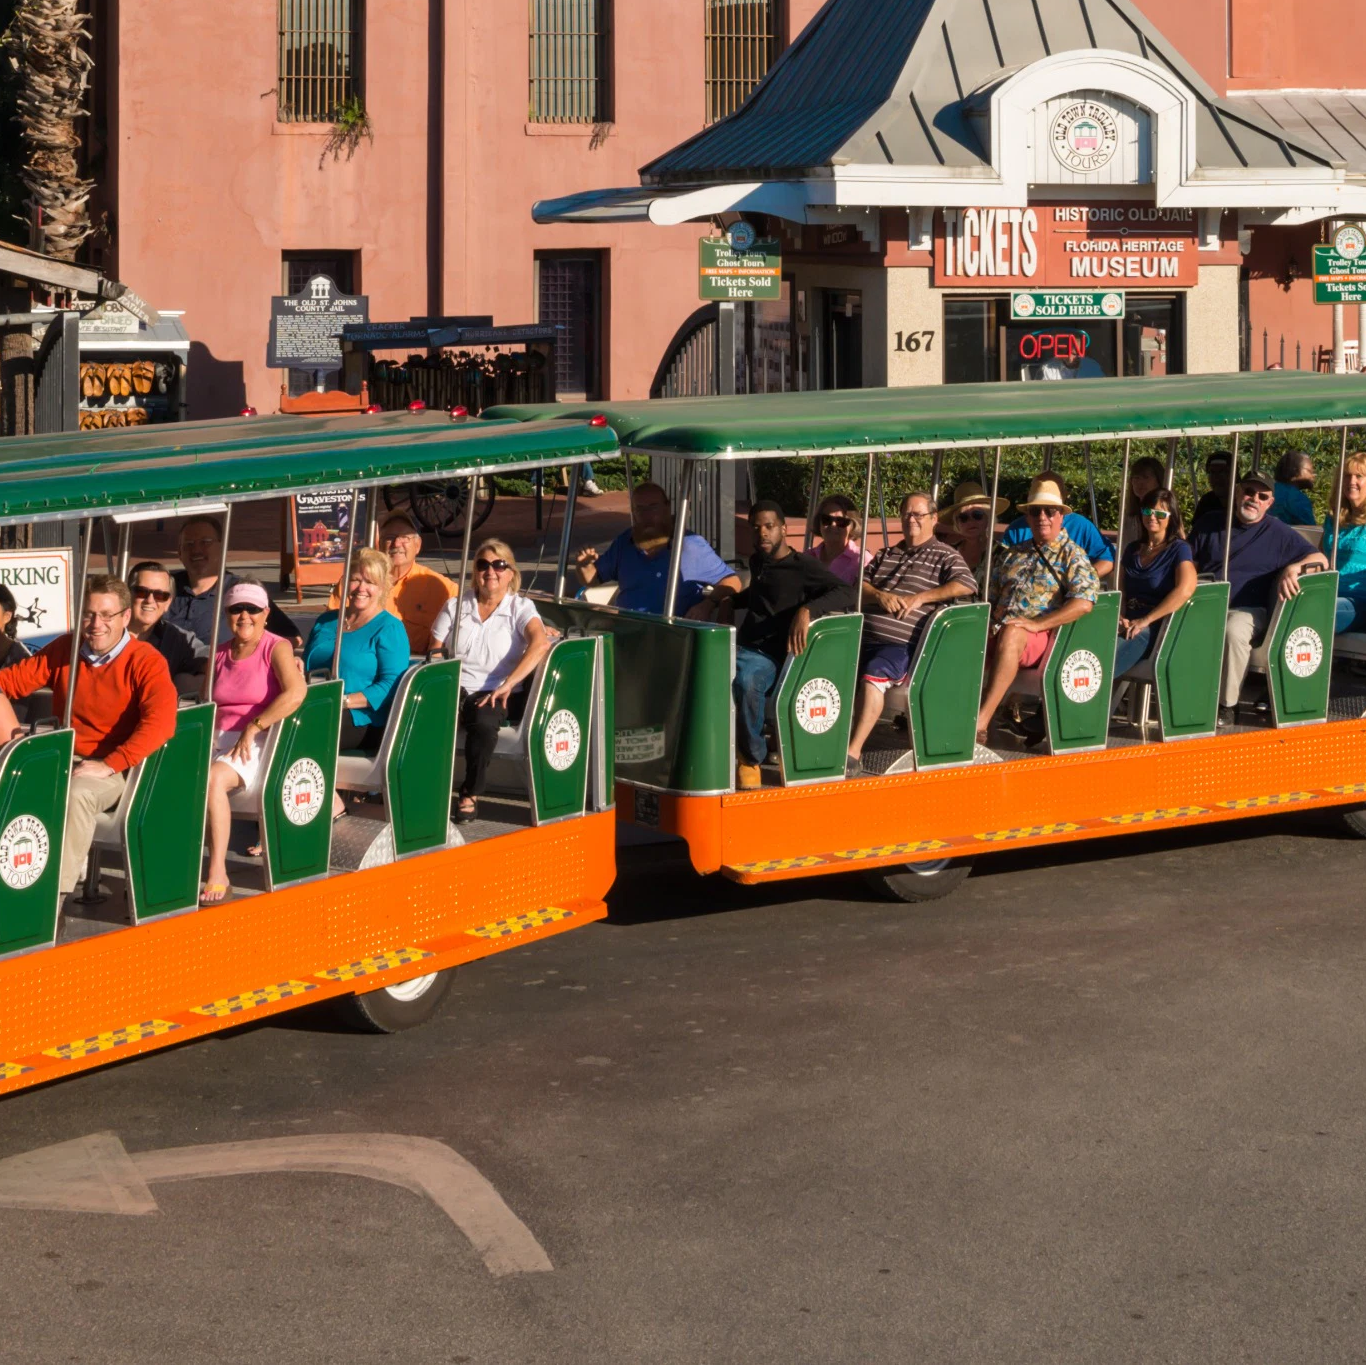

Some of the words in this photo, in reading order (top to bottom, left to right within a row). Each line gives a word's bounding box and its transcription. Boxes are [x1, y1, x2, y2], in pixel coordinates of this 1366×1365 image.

[1061, 104, 1086, 124] TOWN
[1089, 105, 1116, 141] TROLLEY
[1055, 123, 1068, 141] OLD
[1065, 149, 1109, 169] TOURS
[1054, 207, 1126, 221] HISTORIC
[1128, 208, 1159, 221] OLD
[1163, 208, 1193, 221] JAIL
[943, 208, 1038, 277] TICKETS
[1066, 241, 1120, 252] FLORIDA
[1122, 241, 1184, 252] HERITAGE
[714, 248, 742, 259] Trolley
[716, 258, 740, 267] Ghost
[742, 259, 765, 267] Tours
[1070, 256, 1179, 278] MUSEUM
[1327, 259, 1352, 268] Trolley
[1329, 267, 1350, 275] Ghost
[709, 276, 747, 287] Tickets
[748, 276, 772, 287] Sold
[1326, 282, 1356, 292] Tickets
[728, 287, 753, 298] Here
[1043, 294, 1094, 305] TICKETS
[1341, 292, 1362, 301] Here
[1035, 305, 1067, 316] SOLD
[1069, 304, 1101, 316] HERE
[366, 323, 406, 331] CRACKER
[391, 330, 426, 339] ALARMS
[894, 330, 935, 353] 167
[1019, 334, 1086, 359] OPEN
[296, 493, 366, 505] GRAVESTONS
[800, 680, 819, 700] TOWN
[821, 679, 840, 713] TROLLEY
[1068, 689, 1096, 702] TOURS
[796, 698, 805, 714] OLD
[803, 717, 835, 733] TOURS
[551, 753, 575, 768] TOURS
[288, 762, 304, 783] TOWN
[306, 761, 323, 794] TROLLEY
[290, 806, 318, 822] TOURS
[0, 846, 8, 863] OLD
[4, 819, 23, 843] TOWN
[26, 818, 47, 854] TROLLEY
[6, 865, 42, 886] TOURS
